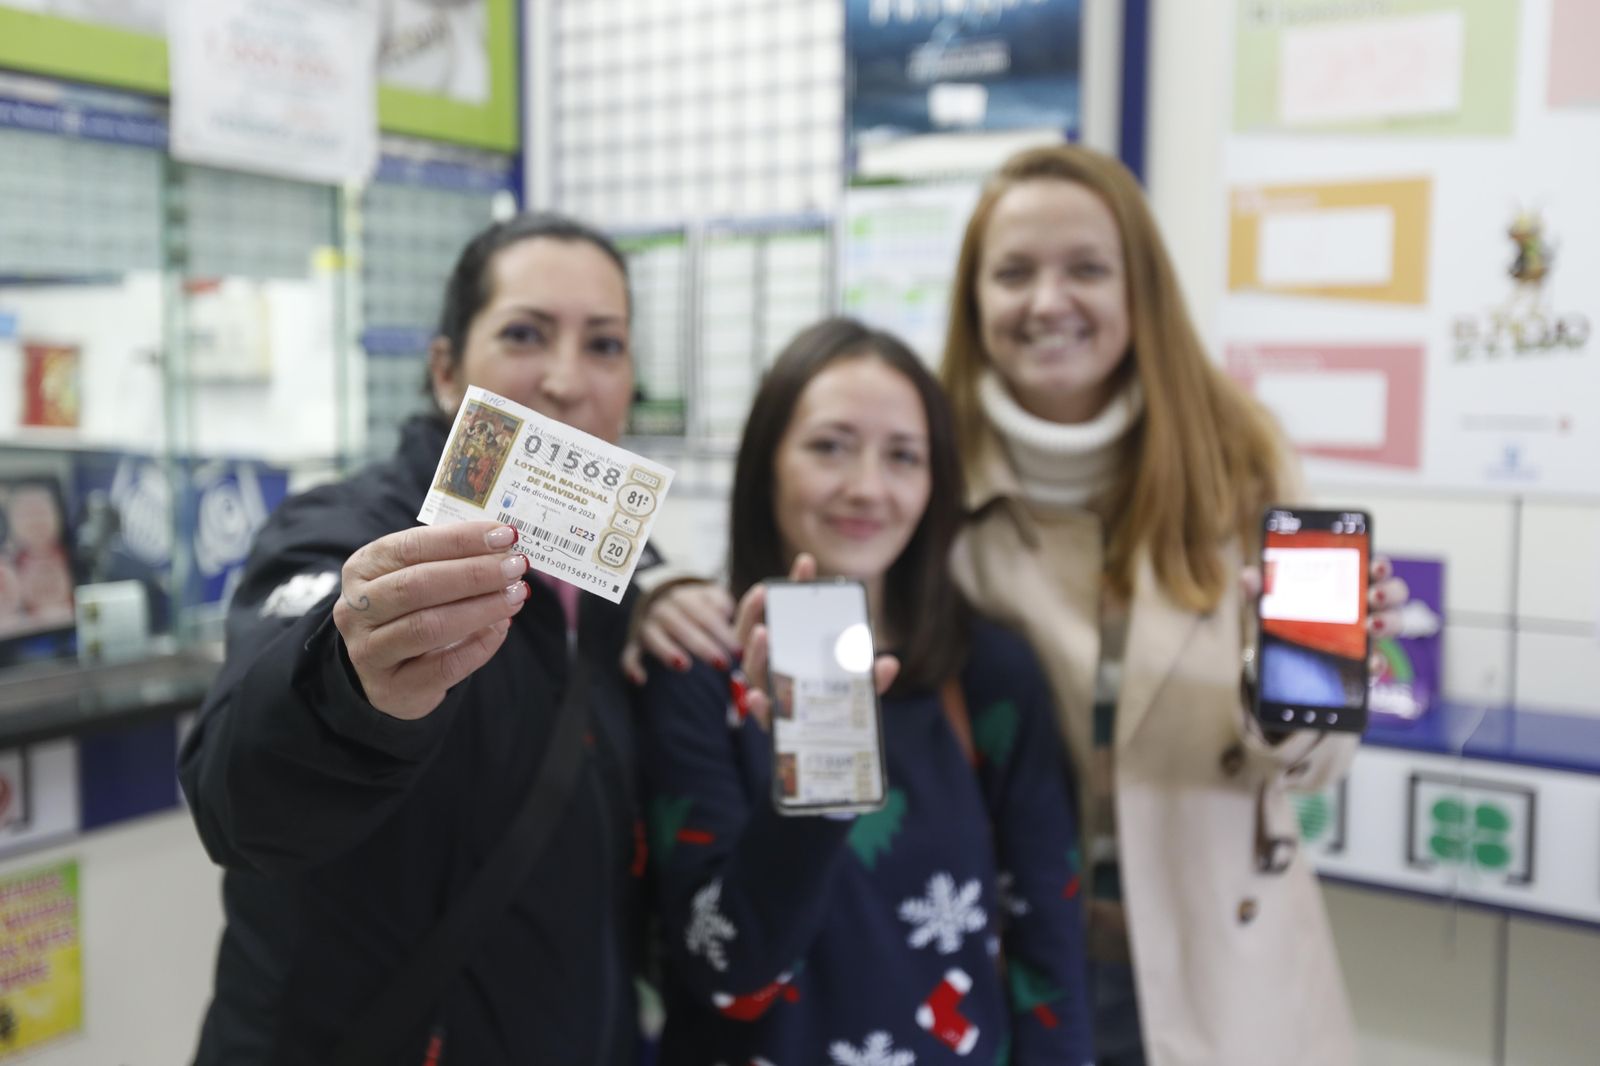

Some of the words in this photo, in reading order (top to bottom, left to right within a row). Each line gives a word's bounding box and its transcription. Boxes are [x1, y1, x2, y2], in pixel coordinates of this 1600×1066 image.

[514, 458, 556, 481] LOTERÍA
[558, 479, 608, 503] NACIONAL
[524, 434, 621, 487] 01568
[511, 480, 521, 489] 22
[521, 484, 531, 492] de
[532, 488, 567, 507] diciembre
[567, 503, 578, 512] de
[578, 508, 596, 520] 2023
[527, 475, 541, 486] DE
[542, 482, 589, 506] NAVIDAD
[608, 543, 623, 558] 20
